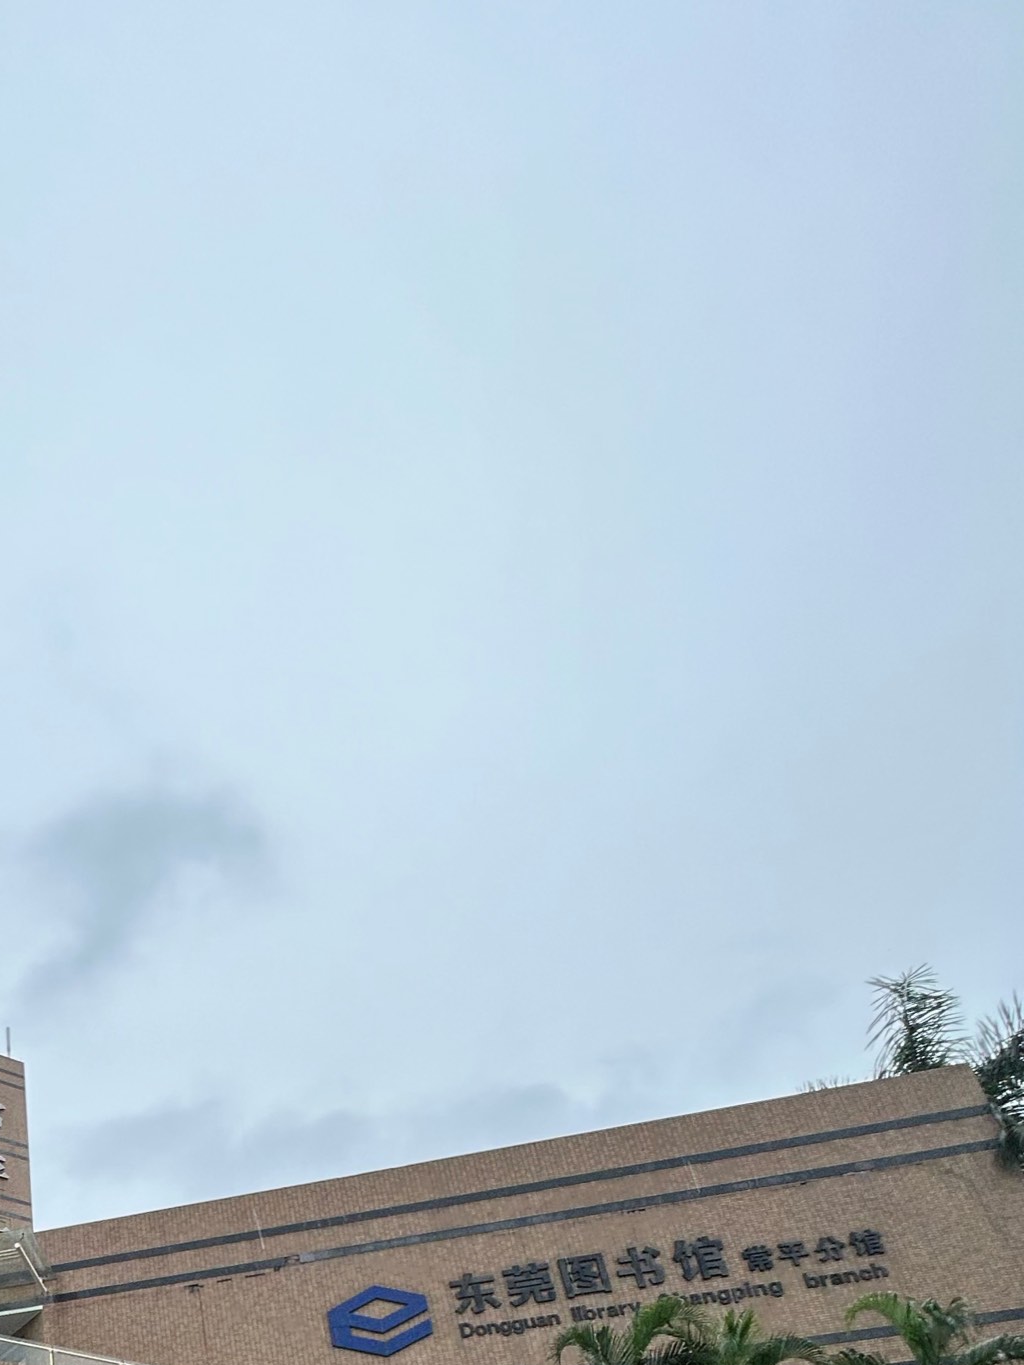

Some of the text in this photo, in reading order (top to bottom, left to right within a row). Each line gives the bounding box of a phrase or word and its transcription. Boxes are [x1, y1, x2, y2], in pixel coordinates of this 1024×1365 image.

[449, 1229, 885, 1315] 东莞图书馆 常平分馆
[459, 1312, 561, 1339] Dongguan
[803, 1263, 889, 1289] branch
